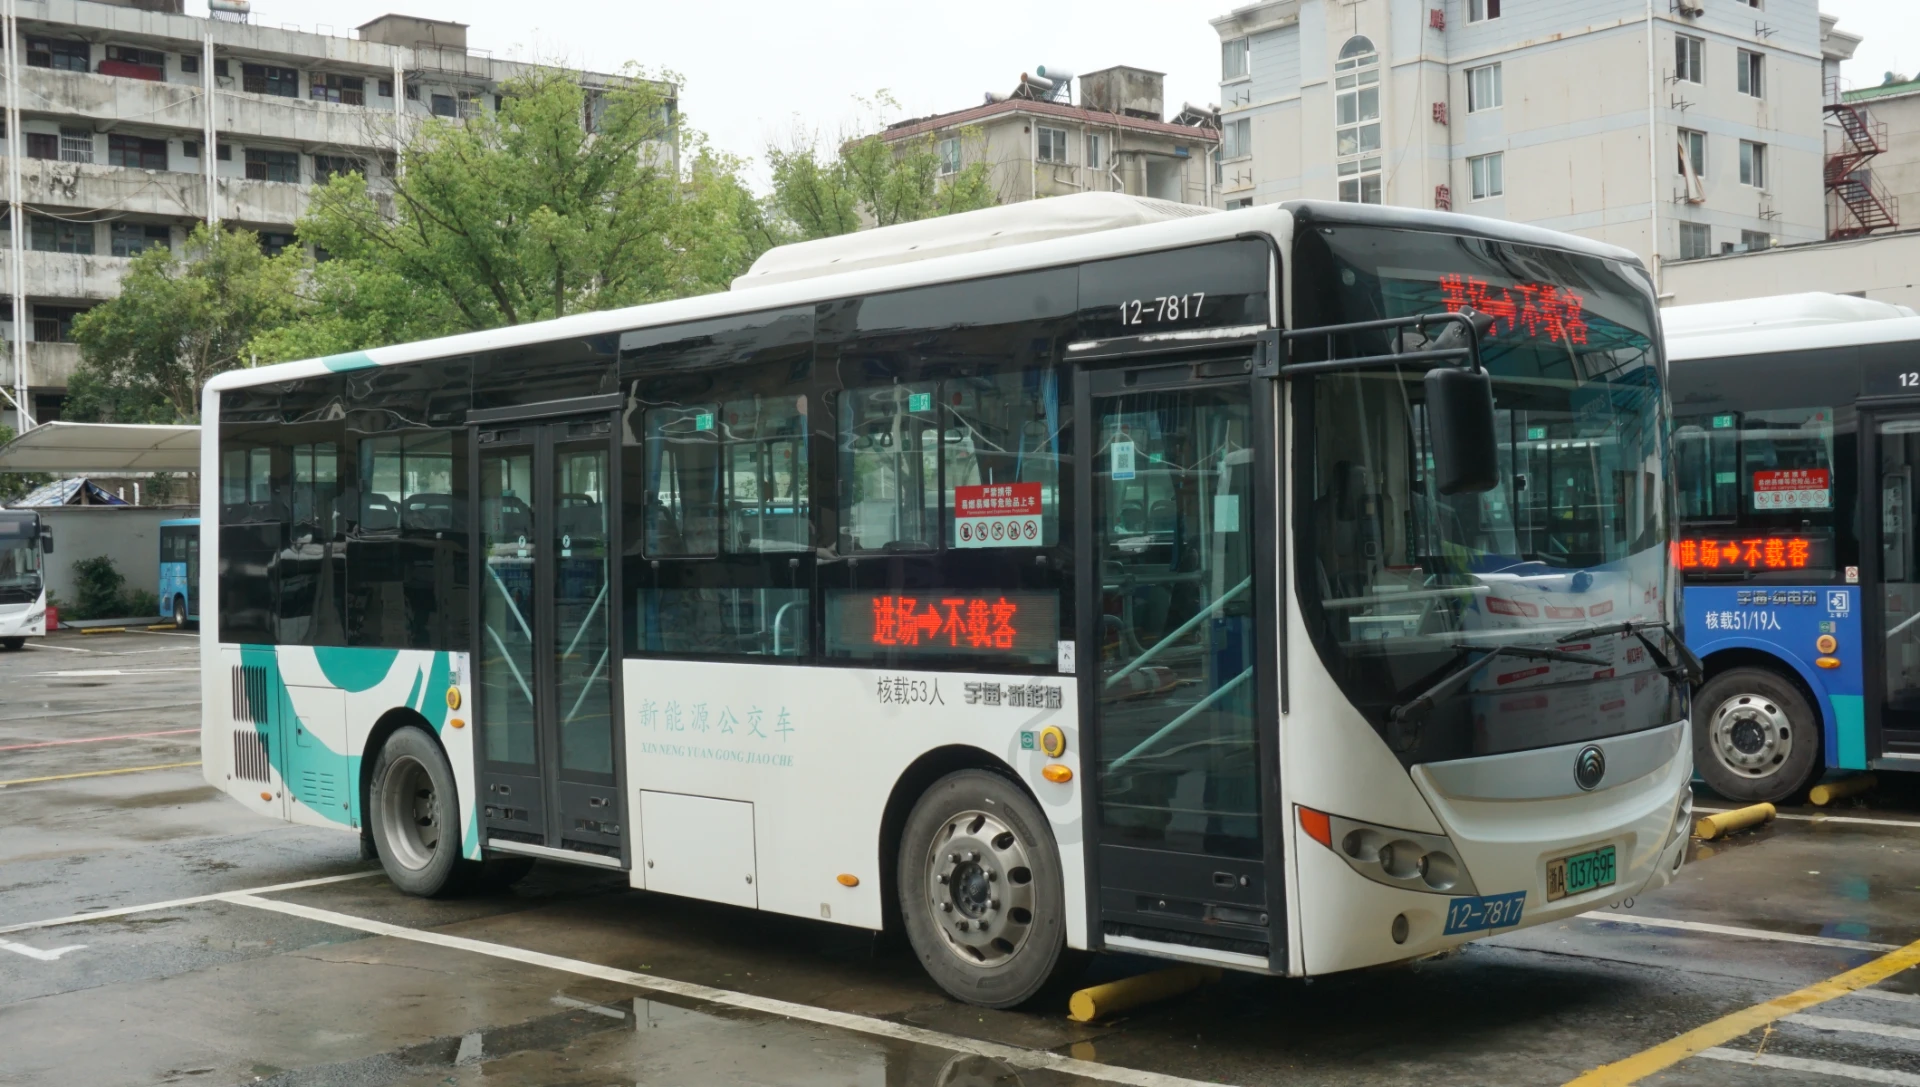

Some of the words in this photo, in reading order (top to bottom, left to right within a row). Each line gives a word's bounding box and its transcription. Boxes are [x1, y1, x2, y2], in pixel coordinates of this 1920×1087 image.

[1119, 291, 1205, 326] 12-7817
[1705, 610, 1782, 631] 核载51/19人
[876, 675, 945, 706] 核载53人
[638, 698, 796, 744] 新能源公交车
[641, 742, 658, 754] XIN
[659, 743, 685, 757] NENG
[687, 746, 714, 759] YUAN
[715, 748, 744, 763] GONG
[745, 751, 770, 765] JIAO
[771, 753, 794, 768] CHE
[1449, 896, 1526, 930] 12-7817
